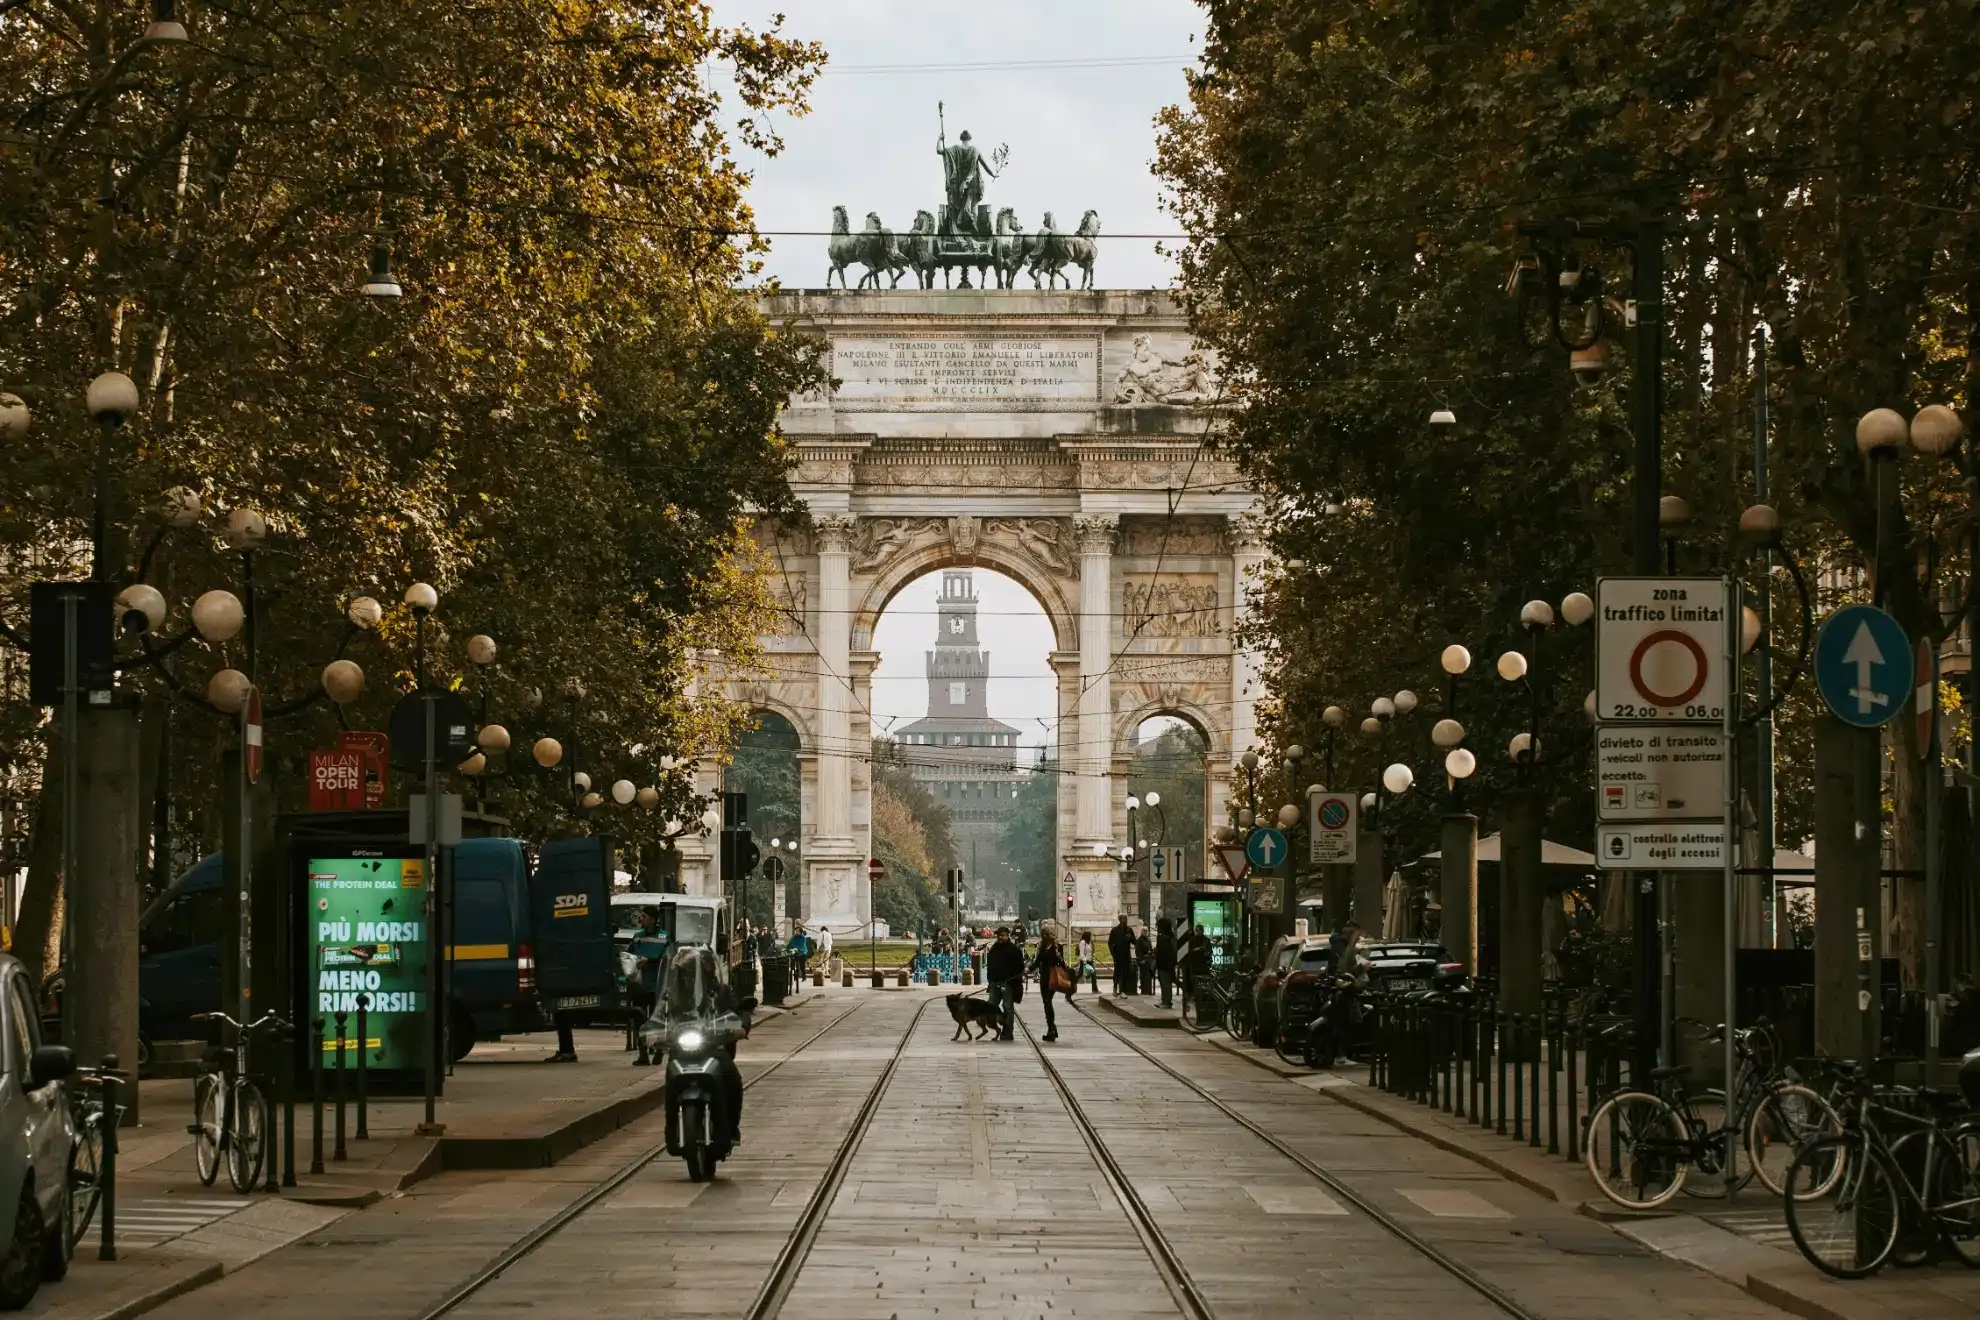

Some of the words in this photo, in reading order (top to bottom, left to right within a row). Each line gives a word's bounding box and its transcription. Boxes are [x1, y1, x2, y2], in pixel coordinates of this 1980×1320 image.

[1652, 589, 1688, 600] zona
[1604, 606, 1666, 621] traffico
[1671, 606, 1724, 621] limitat
[1600, 738, 1644, 748] divieto
[1648, 737, 1661, 748] di
[1666, 736, 1716, 747] transito
[315, 755, 359, 767] MILAN
[1647, 754, 1668, 762] non
[1673, 752, 1724, 762] autorizza
[316, 767, 359, 778] OPEN
[1602, 772, 1647, 780] eccetto:
[316, 778, 359, 790] TOUR
[1633, 834, 1678, 844] controllo
[1681, 834, 1724, 844] elettroni
[1648, 848, 1676, 859] degli
[1681, 848, 1720, 858] accessi
[554, 893, 588, 909] SDA
[318, 916, 351, 942] PIÙ
[356, 922, 419, 942] MORSI
[318, 970, 381, 991] MENO
[318, 991, 416, 1012] RIMORSI!
